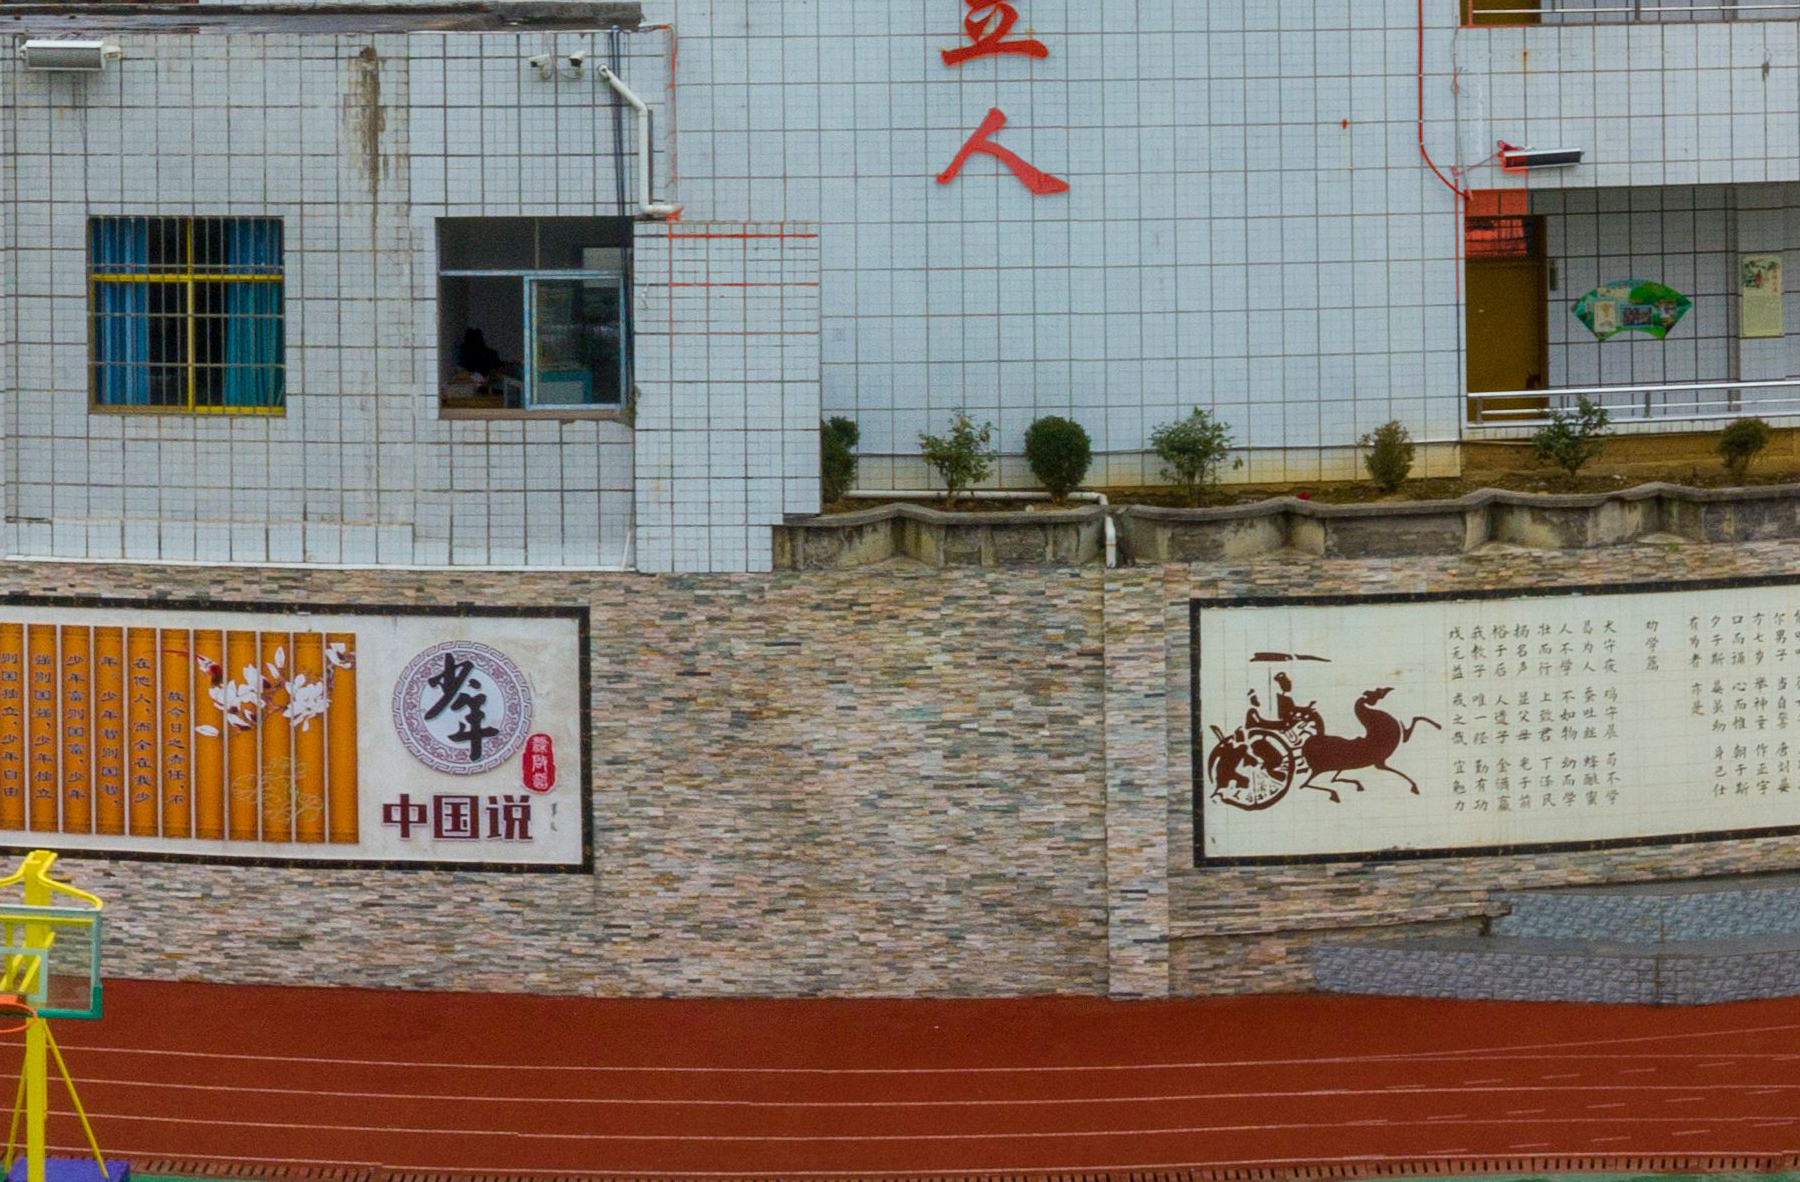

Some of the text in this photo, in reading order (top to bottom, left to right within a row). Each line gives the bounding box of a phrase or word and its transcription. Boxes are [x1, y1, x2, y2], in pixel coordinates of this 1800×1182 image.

[424, 652, 500, 762] 少年
[382, 793, 534, 840] 中国说
